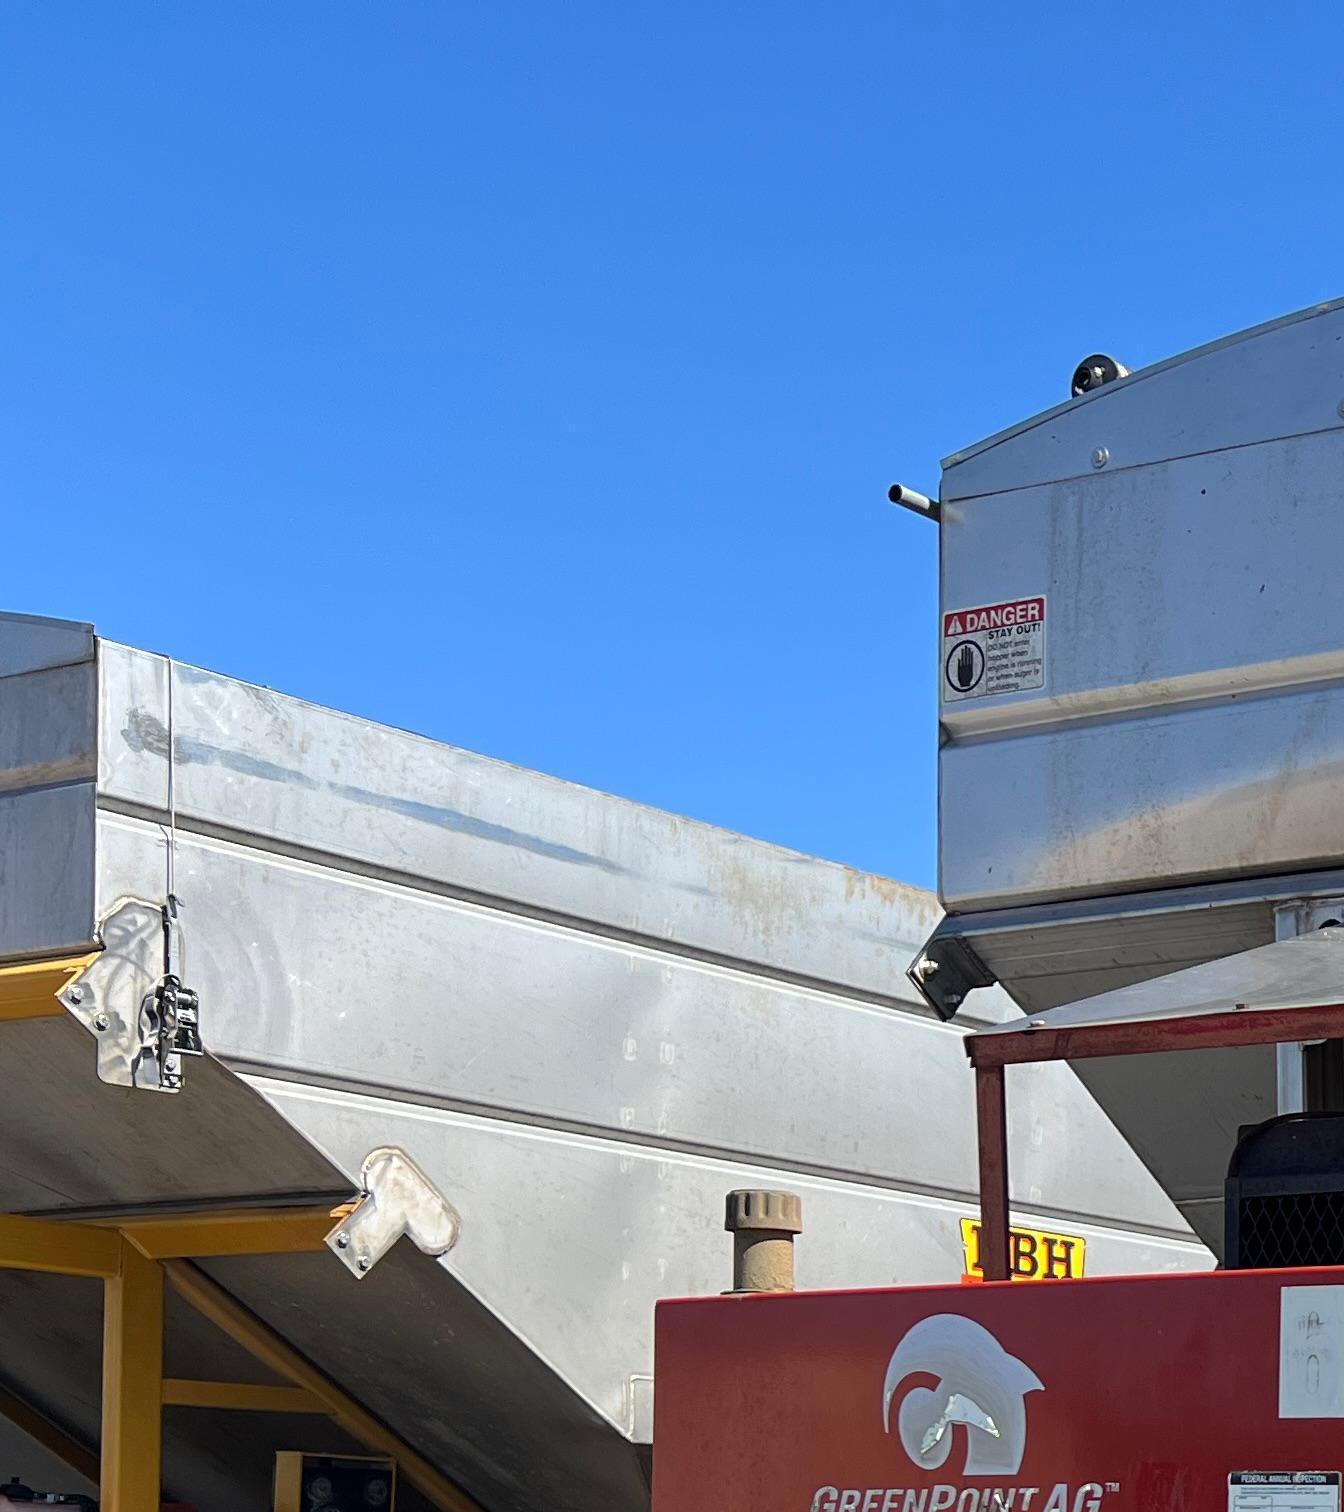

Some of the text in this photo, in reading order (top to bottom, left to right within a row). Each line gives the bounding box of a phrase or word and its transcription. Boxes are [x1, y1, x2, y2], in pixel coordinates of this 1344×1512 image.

[966, 602, 1040, 633] DANGER
[988, 623, 1041, 640] STAY OUT!
[1241, 1474, 1268, 1484] FEDERAL
